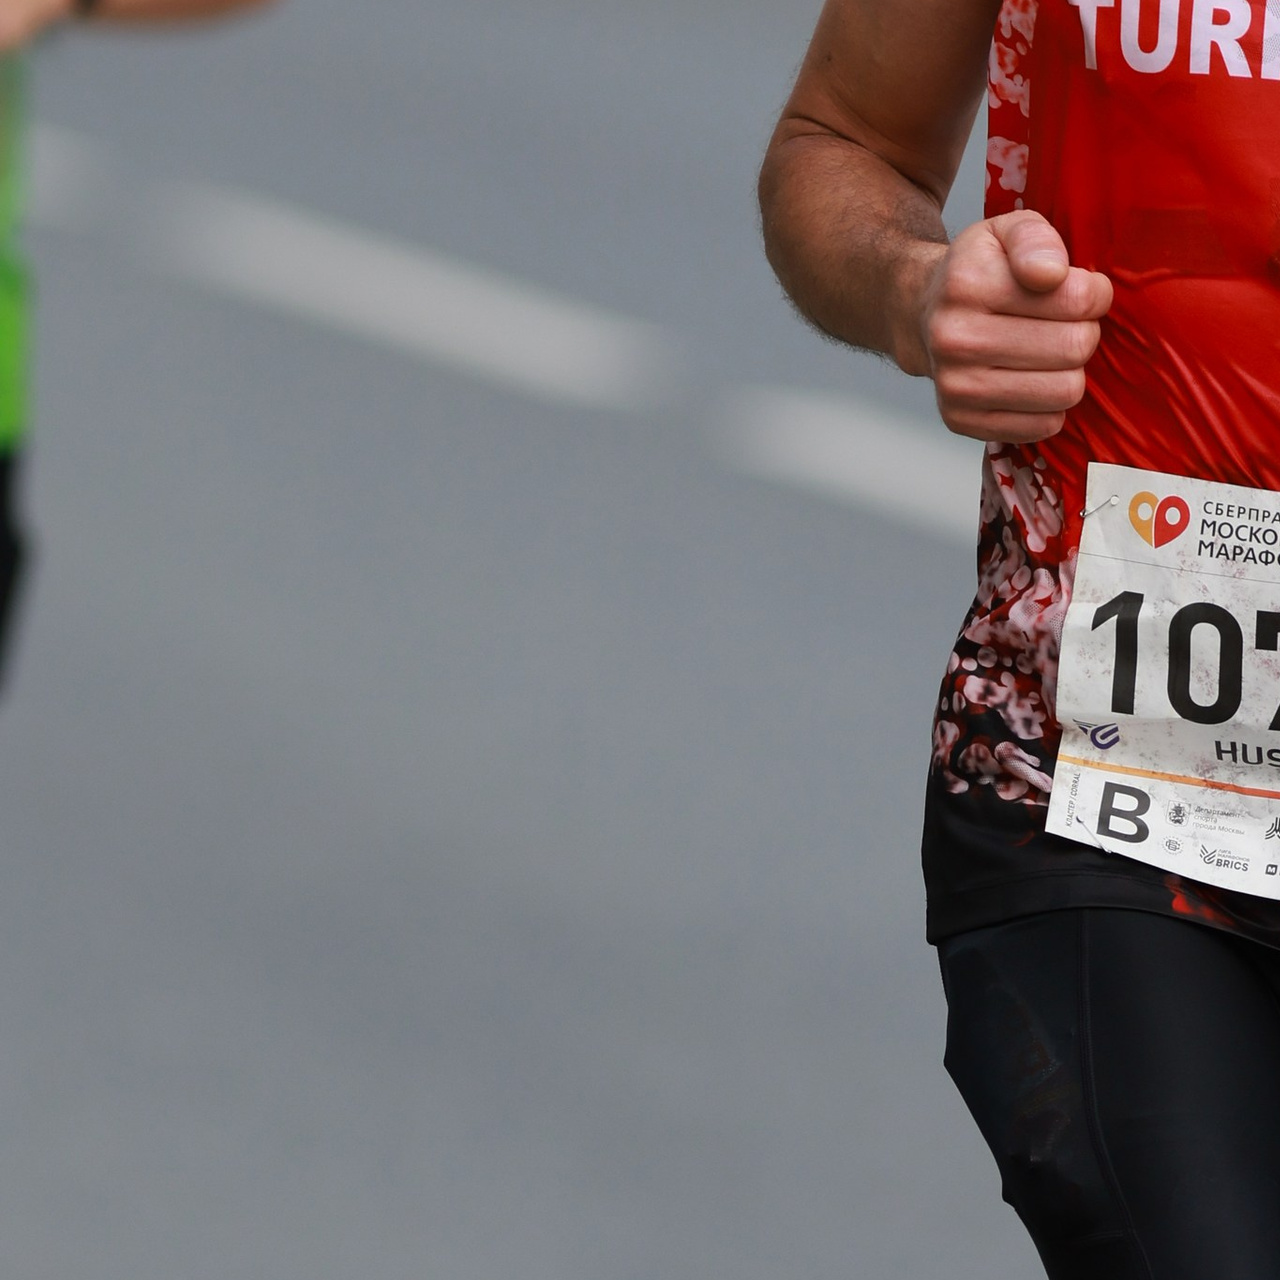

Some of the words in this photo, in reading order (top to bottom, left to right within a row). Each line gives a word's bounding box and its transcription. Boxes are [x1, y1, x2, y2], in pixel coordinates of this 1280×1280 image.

[1065, 800, 1075, 827] КЛАСТЕР
[1070, 772, 1080, 796] CORRAL
[1216, 858, 1249, 872] BRICS
